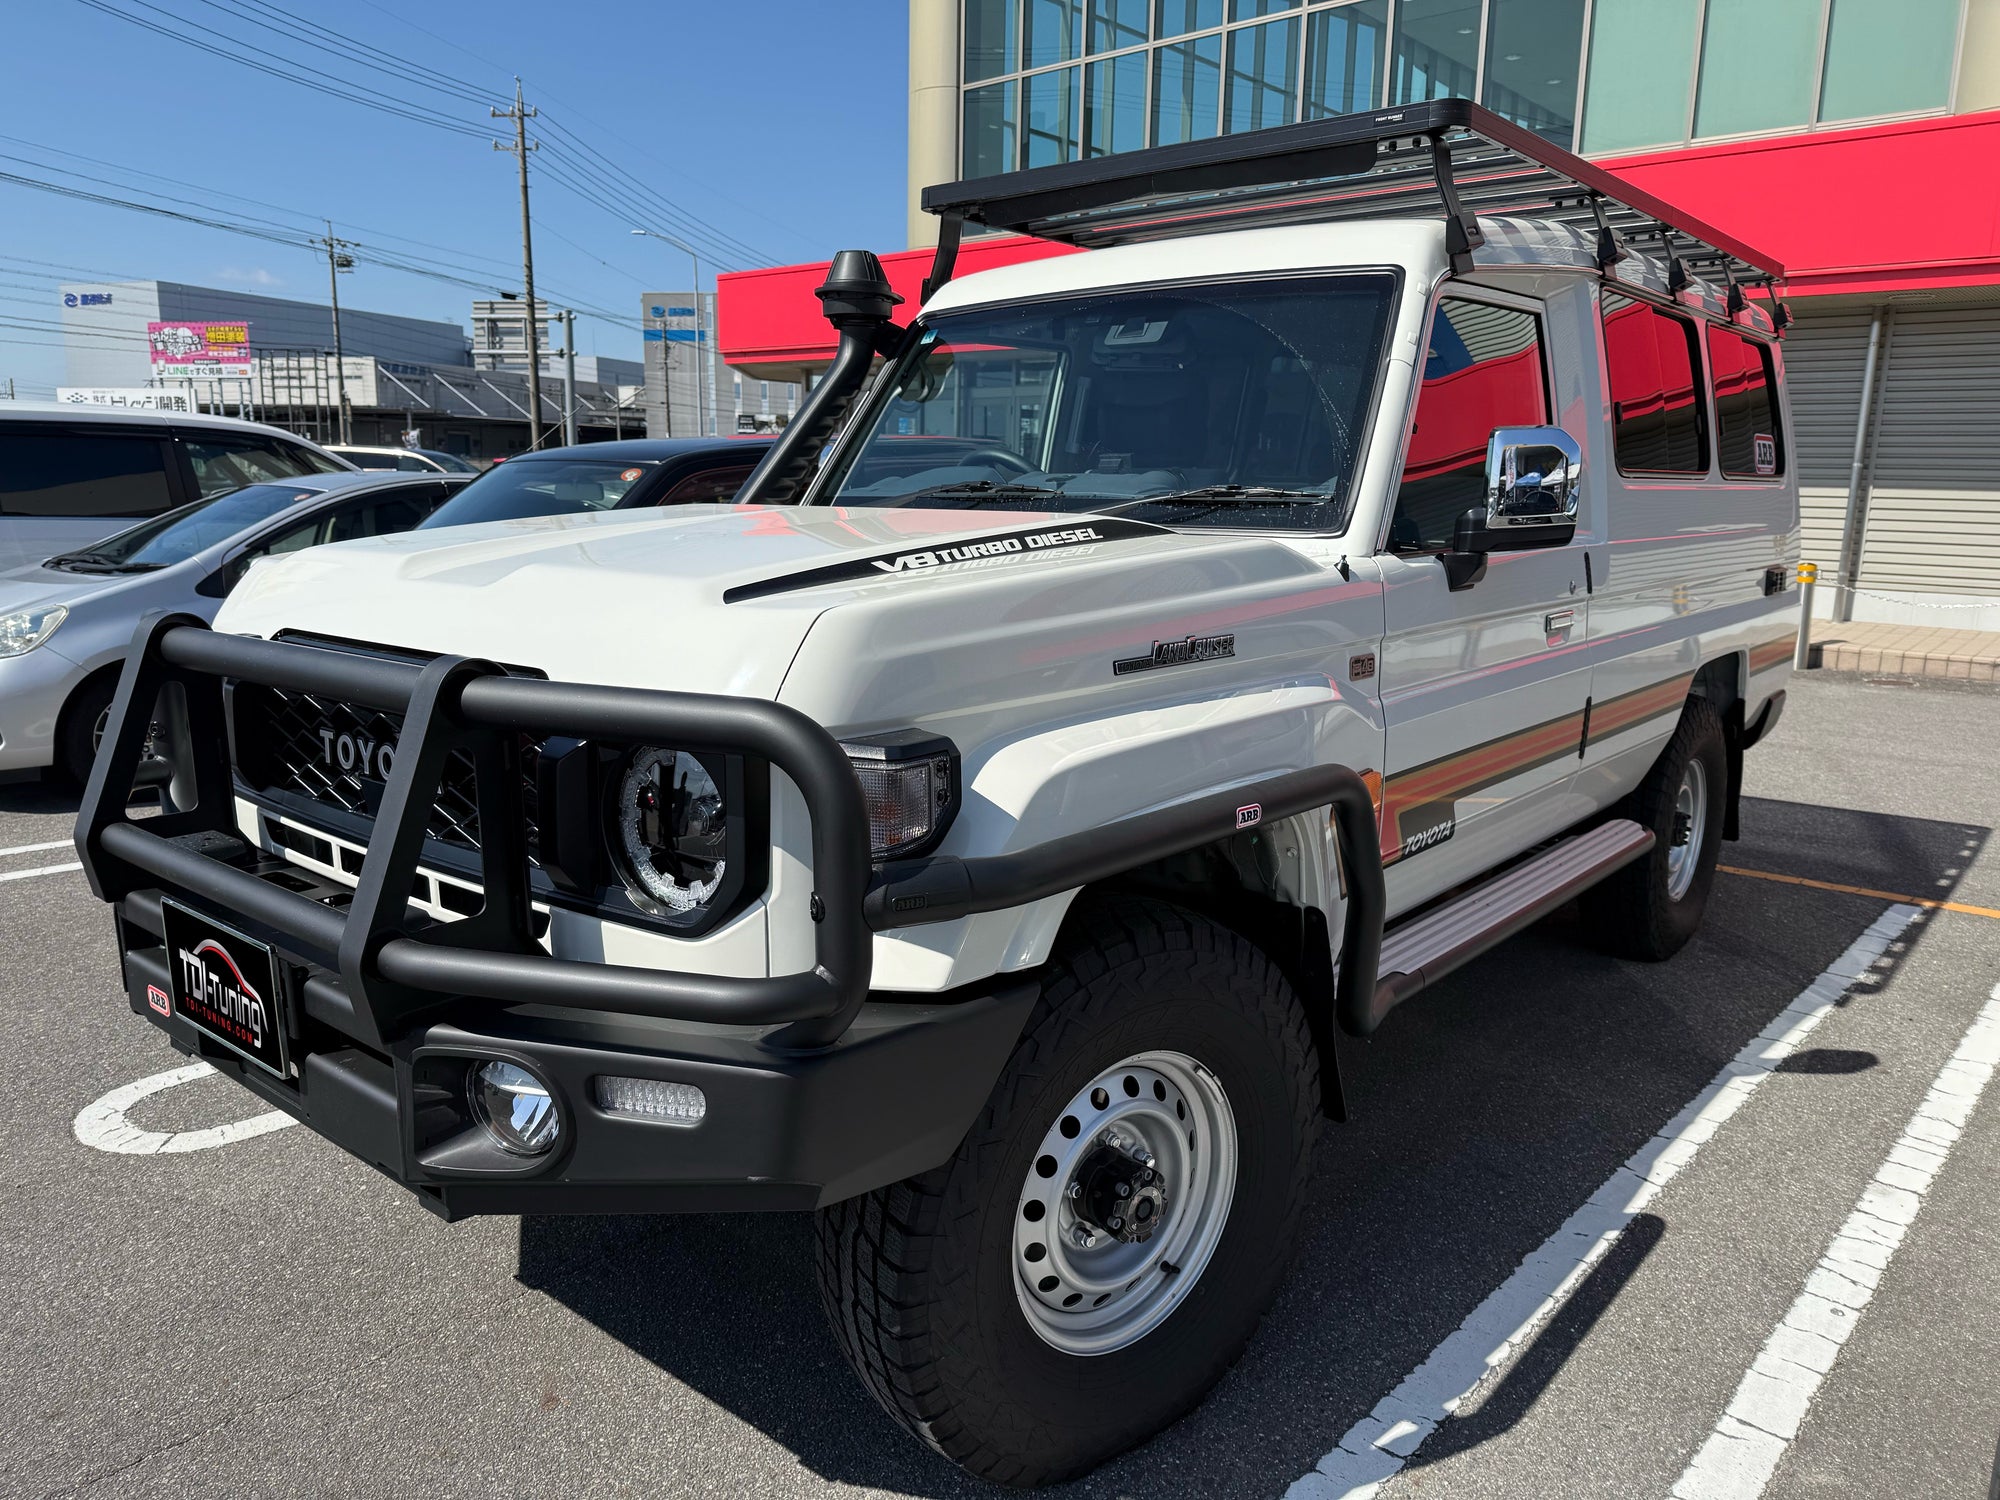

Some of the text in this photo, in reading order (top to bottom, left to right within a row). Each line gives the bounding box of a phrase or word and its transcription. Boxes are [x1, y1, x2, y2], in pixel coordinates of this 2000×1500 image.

[1757, 442, 1774, 466] ARB
[871, 527, 1104, 573] V8 TURBO DIESEL
[319, 729, 395, 781] TOYO
[1239, 809, 1259, 824] ARB
[1405, 820, 1452, 855] TOYOTA
[896, 897, 925, 911] ARB
[150, 990, 167, 1011] ARB
[179, 947, 262, 1049] TDI-Tuning
[185, 997, 253, 1044] TDI-TUNING.COM
